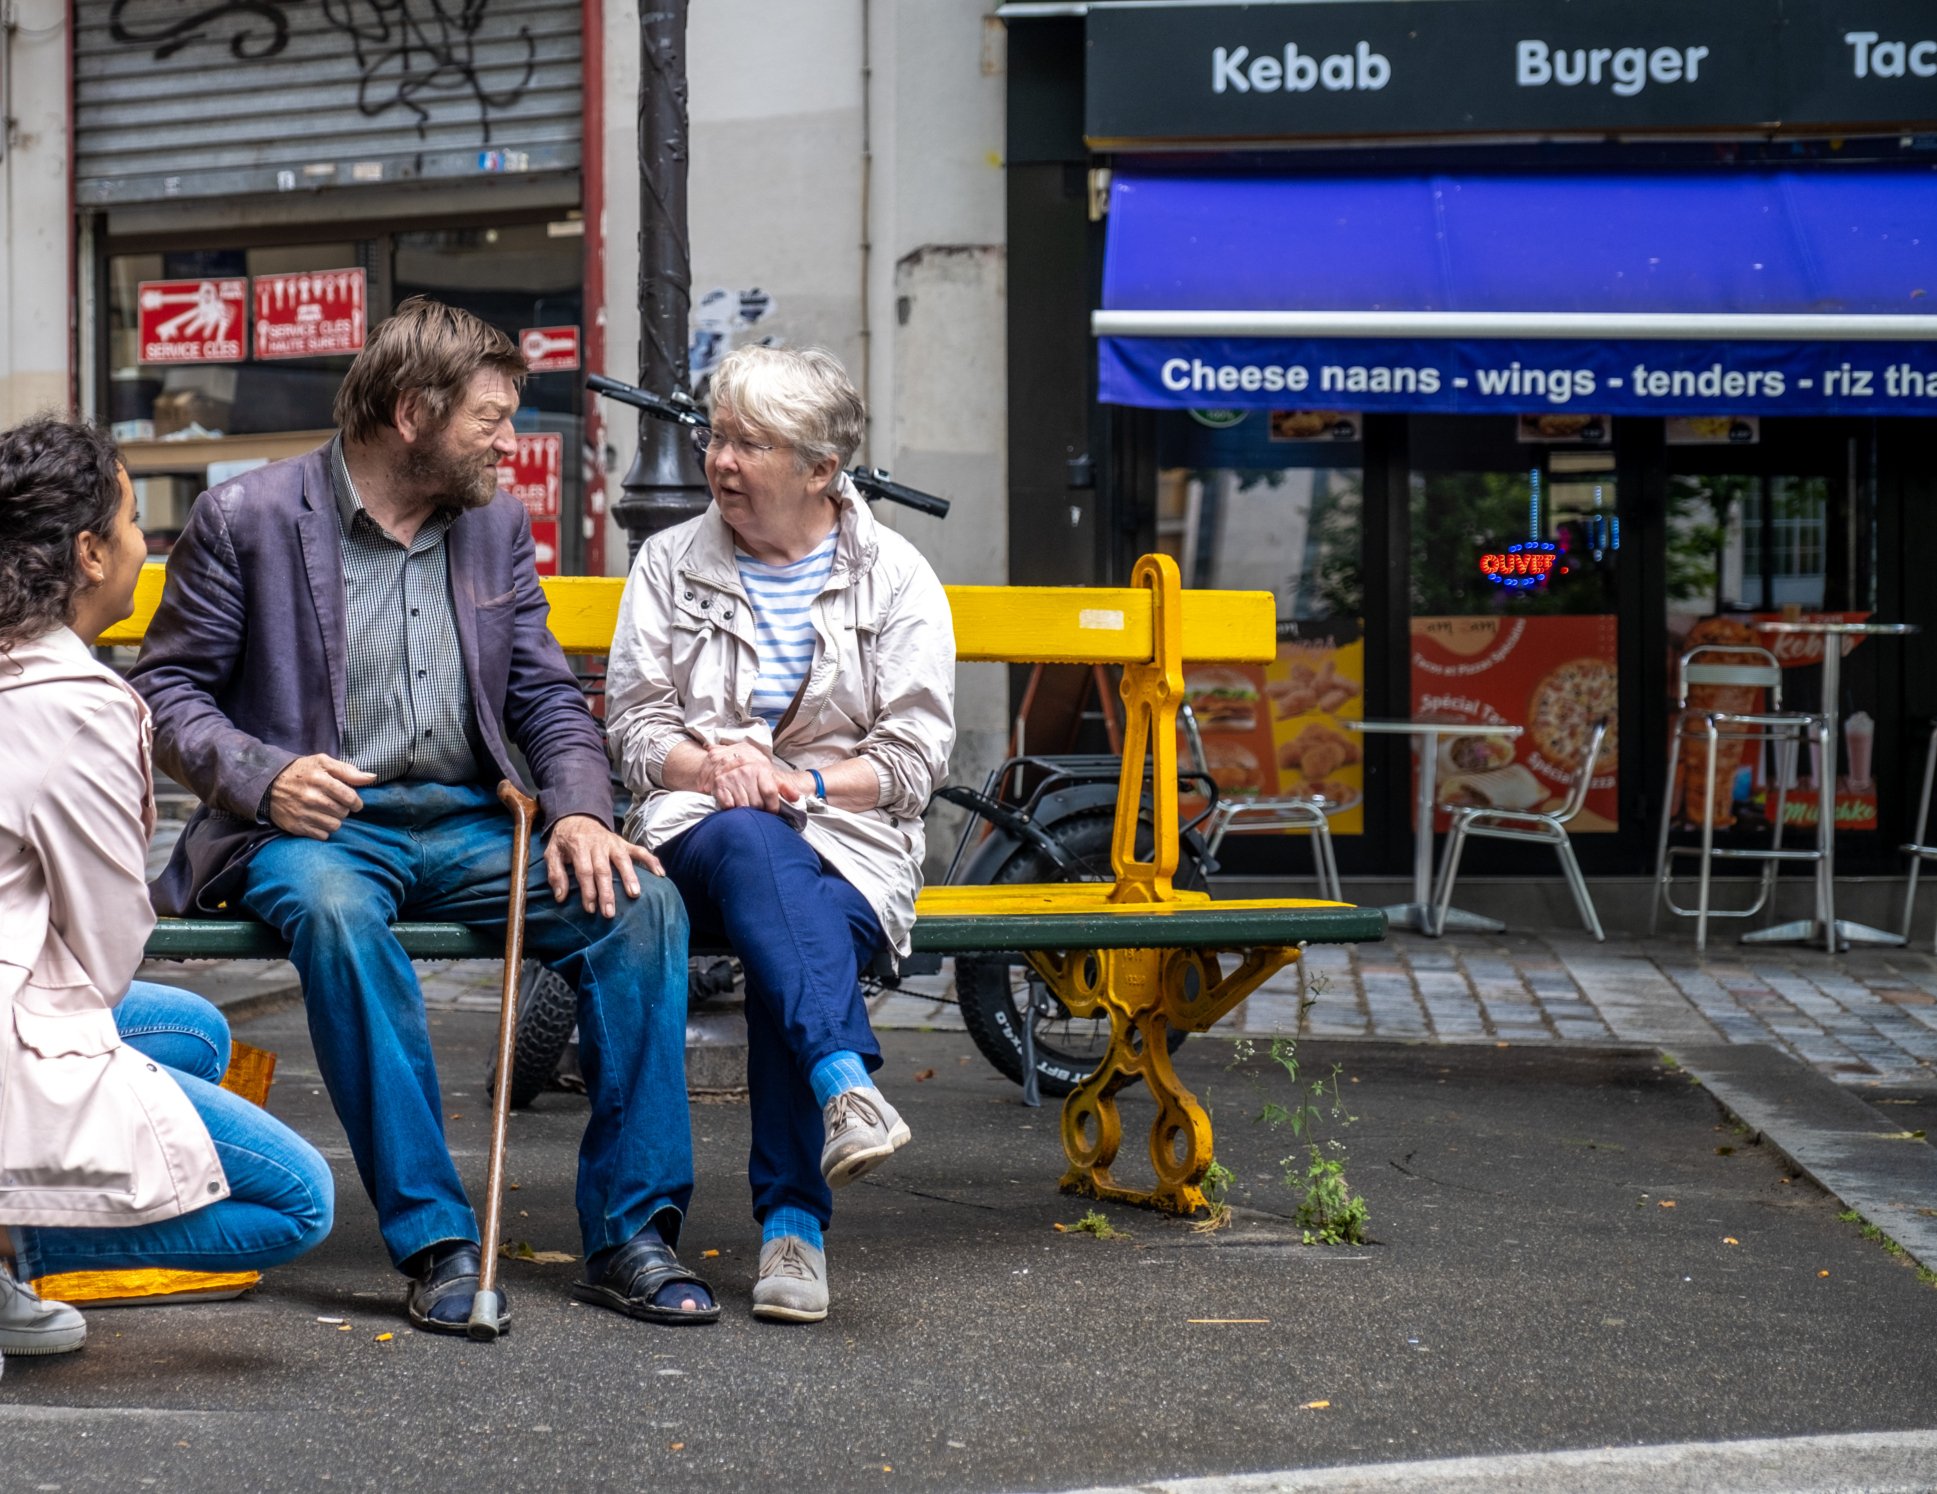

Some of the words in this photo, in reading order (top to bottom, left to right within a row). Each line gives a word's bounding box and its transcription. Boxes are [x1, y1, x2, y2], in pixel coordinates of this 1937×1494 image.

[1211, 40, 1392, 94] Kebab
[1515, 38, 1710, 97] Burger
[1844, 30, 1937, 79] Tac
[266, 322, 318, 339] SERVICE
[145, 341, 202, 360] SERVICE
[1161, 357, 1310, 393] Cheese
[1320, 363, 1442, 395] naans
[1452, 378, 1469, 389] -
[1476, 362, 1597, 404] wings
[1607, 378, 1623, 389] -
[1633, 363, 1787, 398] tenders
[1799, 378, 1814, 389] -
[1823, 362, 1875, 397] riz
[1885, 363, 1937, 398] tha
[1773, 632, 1855, 660] Kebb
[1035, 1061, 1071, 1081] BFT
